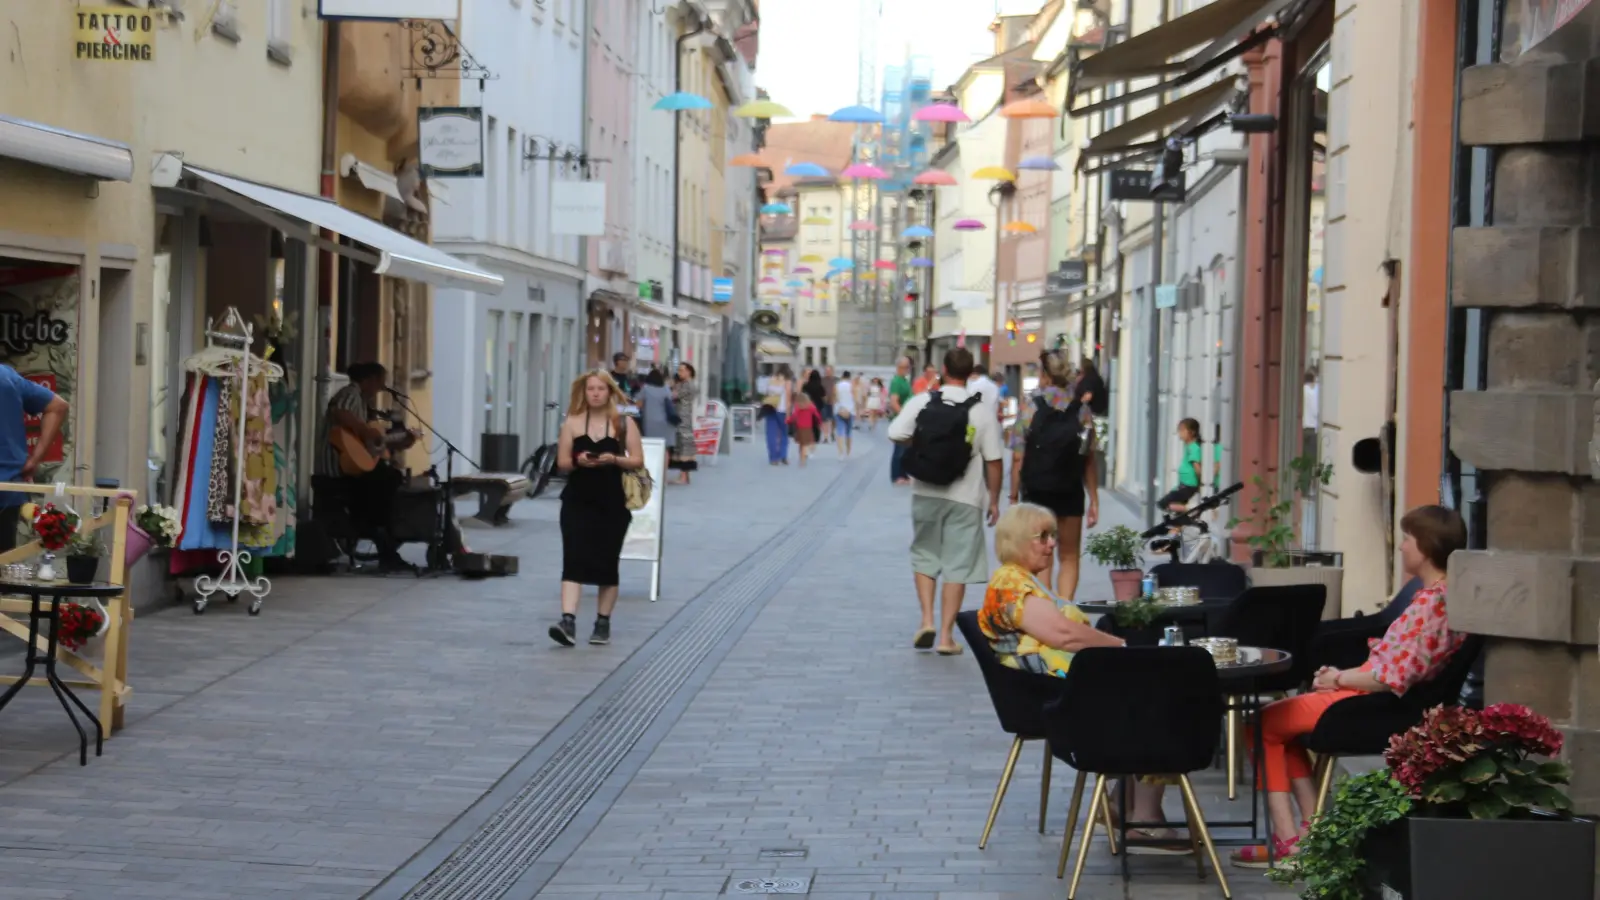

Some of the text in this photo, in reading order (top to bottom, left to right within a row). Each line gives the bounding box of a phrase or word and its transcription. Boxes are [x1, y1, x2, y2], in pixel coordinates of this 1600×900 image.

[77, 13, 151, 32] TATTOO
[103, 26, 120, 45] &
[76, 41, 151, 60] PIERCING
